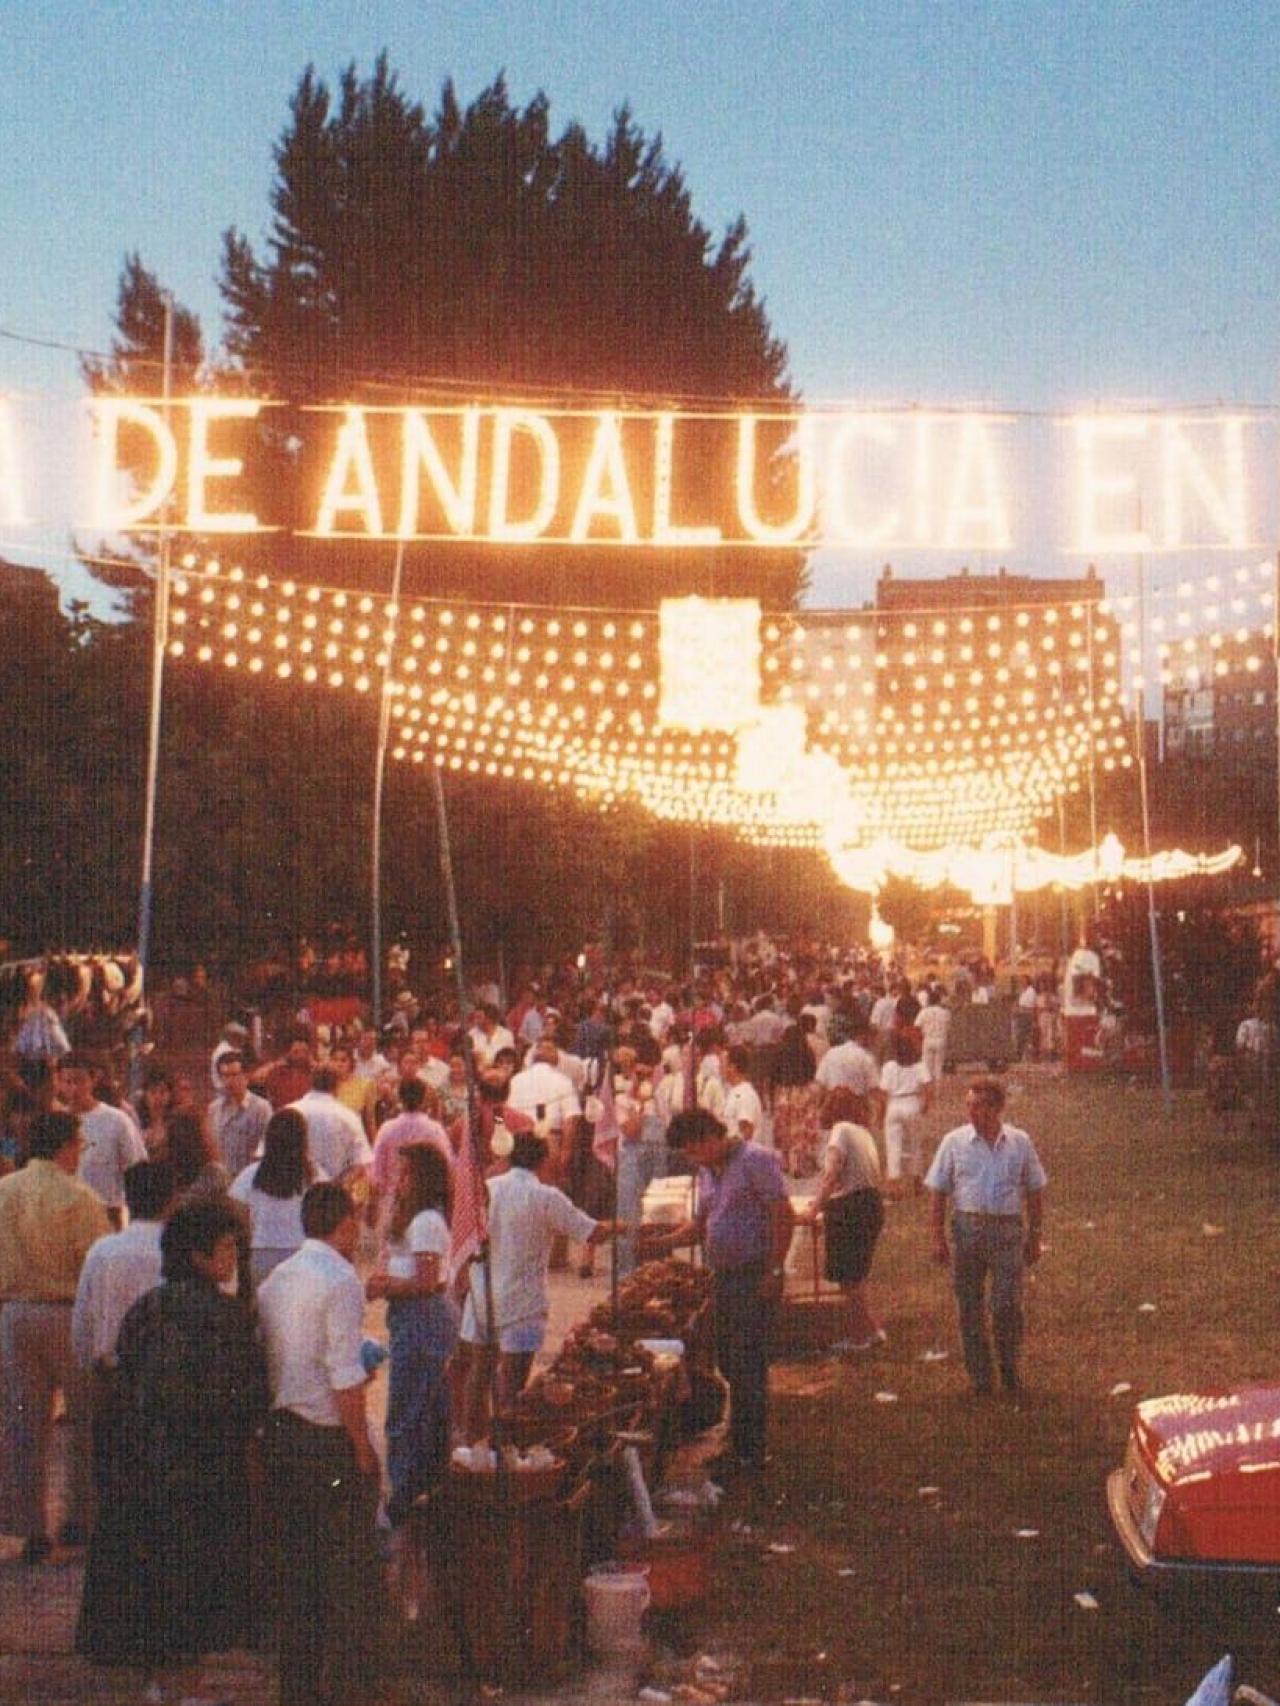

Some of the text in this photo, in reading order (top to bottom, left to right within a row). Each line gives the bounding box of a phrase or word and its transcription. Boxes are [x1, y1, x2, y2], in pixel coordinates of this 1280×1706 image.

[97, 400, 261, 531] DE
[316, 405, 1012, 547] ANDALUCIA
[1077, 416, 1247, 550] EN
